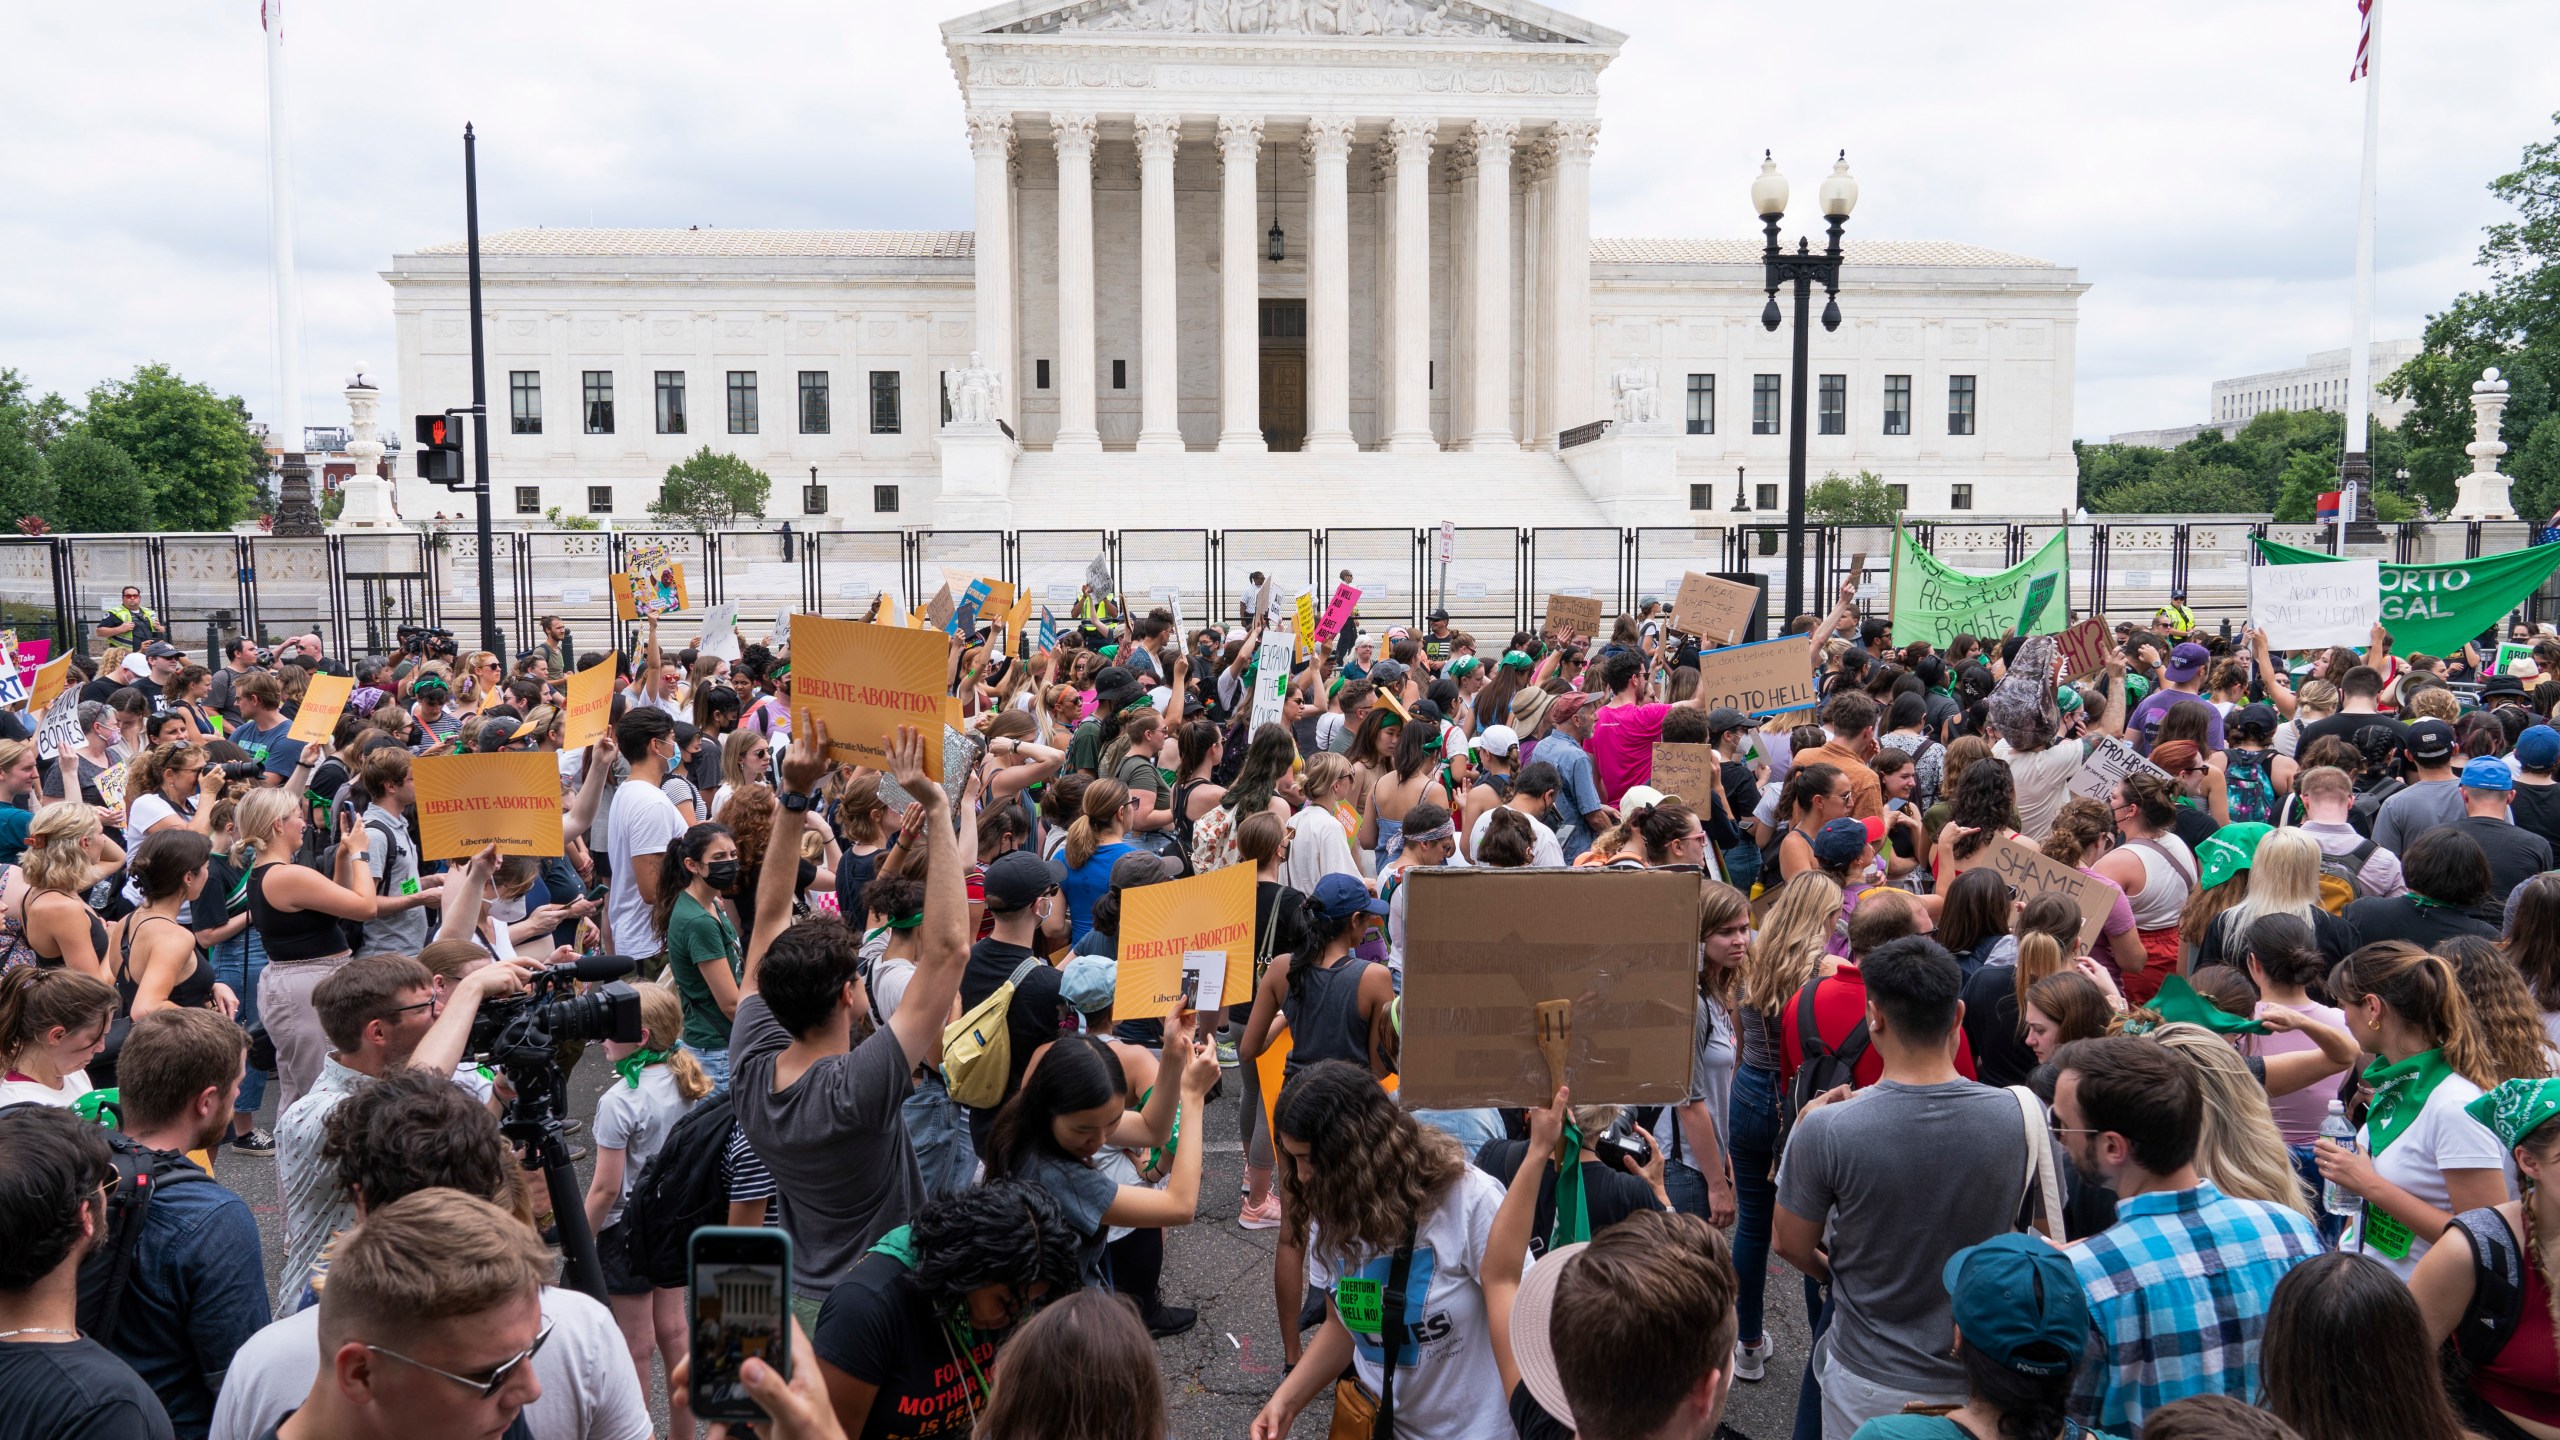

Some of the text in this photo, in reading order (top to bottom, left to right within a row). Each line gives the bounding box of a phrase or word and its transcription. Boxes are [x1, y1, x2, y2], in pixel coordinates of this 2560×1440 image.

[1689, 579, 1700, 592] I
[2267, 569, 2308, 586] KEEP
[2289, 585, 2360, 601] ABORTION
[1332, 598, 1343, 608] AID
[1682, 595, 1735, 616] WHAT THE
[1691, 611, 1722, 626] FUCK?
[2265, 604, 2303, 625] SAFE
[1576, 620, 1598, 633] LIVES
[18, 653, 36, 663] Take
[1260, 644, 1291, 672] EXPAND
[1718, 653, 1744, 666] don't
[1744, 646, 1775, 662] believe
[1777, 647, 1786, 655] in
[1262, 677, 1279, 702] THE
[1706, 675, 1727, 689] but
[1731, 673, 1750, 684] you
[797, 676, 938, 715] LIBERATE ABORTION
[1740, 689, 1765, 712] TO
[1768, 682, 1811, 708] HELL
[570, 695, 600, 719] LIBERATE
[39, 718, 85, 755] BODIES
[827, 736, 887, 757] iberateAbortio
[1655, 745, 1702, 763] So Much
[1665, 763, 1702, 779] protecting
[425, 796, 556, 815] LIBERATE ABORTION
[460, 836, 533, 847] LiberateAbortion.org
[1995, 847, 2084, 897] SHAME
[1125, 921, 1249, 961] LIBERATE ABORTION
[1340, 1280, 1376, 1294] OVERTURN
[1340, 1293, 1359, 1305] ROE?
[1341, 1306, 1379, 1322] HELL NO!
[919, 1418, 940, 1435] IS
